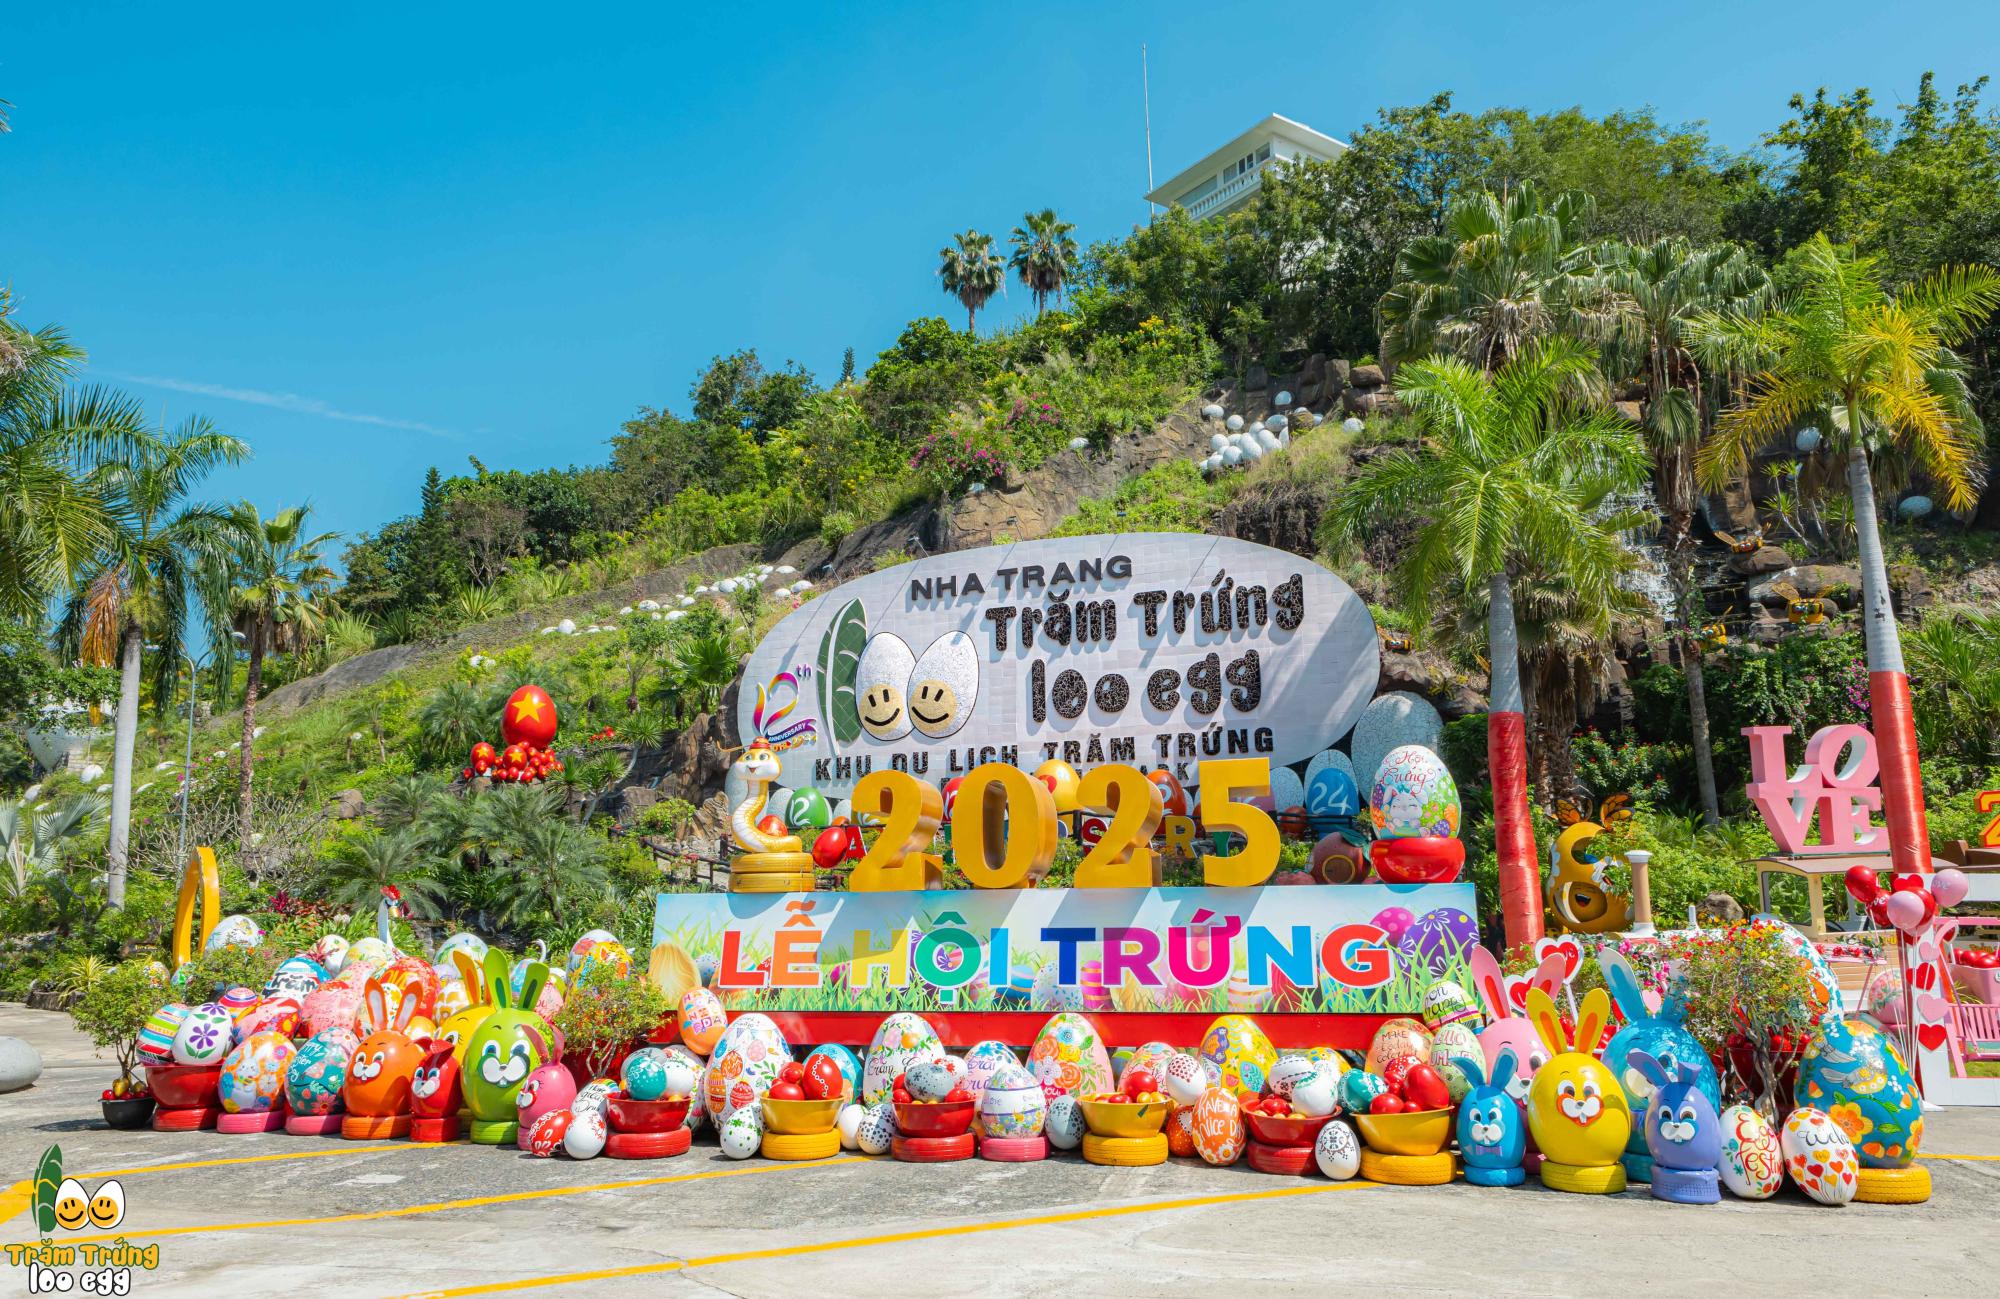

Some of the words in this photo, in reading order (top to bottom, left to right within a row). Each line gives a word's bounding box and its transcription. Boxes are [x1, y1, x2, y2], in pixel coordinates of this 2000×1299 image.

[911, 572, 985, 601] NHA
[997, 555, 1133, 591] TRANG
[985, 588, 1117, 651] Trăm
[1133, 568, 1304, 638] Trứng
[1146, 648, 1262, 715] egg
[816, 754, 872, 781] KHU
[1156, 722, 1274, 759] TRỨNG
[849, 757, 1281, 892] 2025
[1310, 781, 1352, 816] 24
[719, 900, 823, 987] LỄ
[851, 910, 1009, 1003] HỘI
[1041, 908, 1395, 988] TRỨNG
